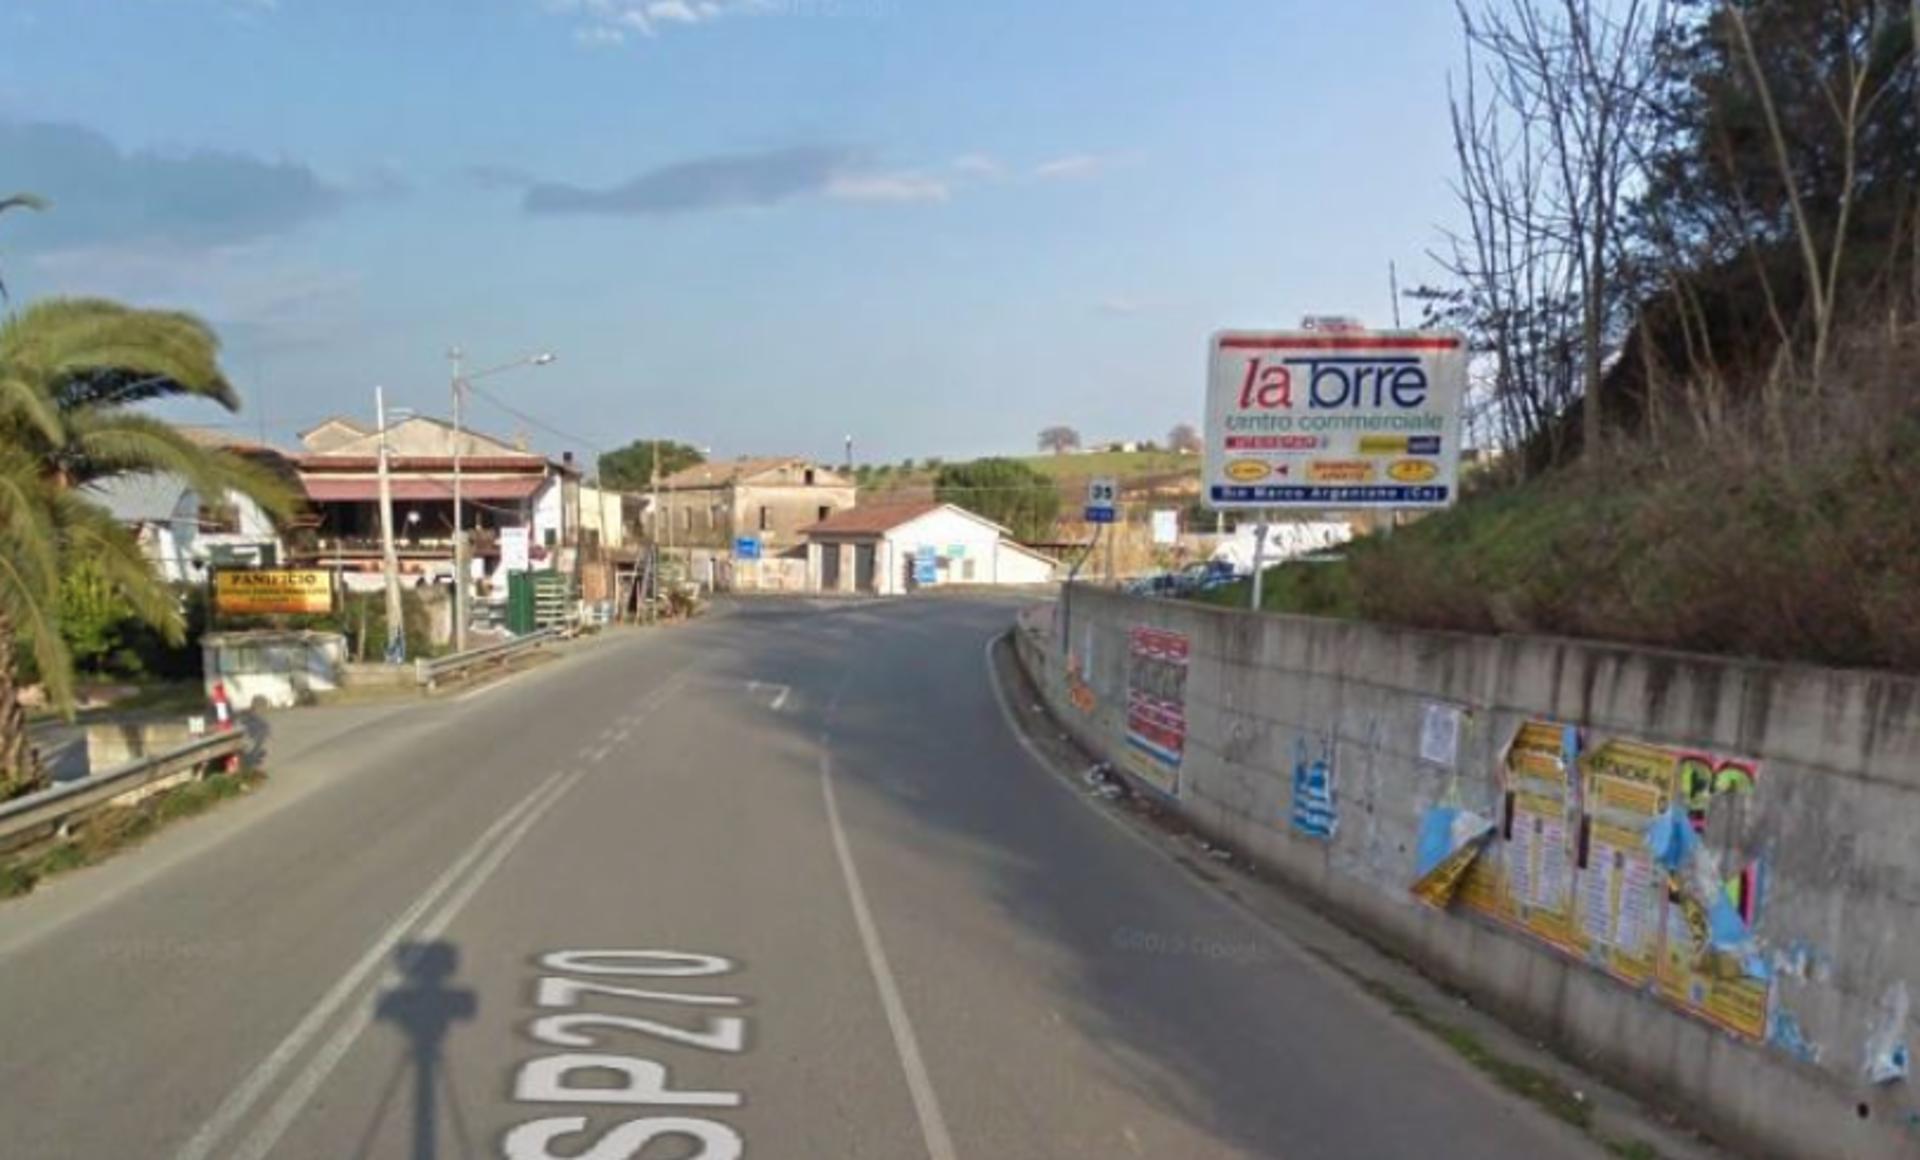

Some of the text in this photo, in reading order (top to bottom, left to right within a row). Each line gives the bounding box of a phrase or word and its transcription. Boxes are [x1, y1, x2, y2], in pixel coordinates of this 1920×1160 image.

[1238, 357, 1428, 410] la Torre
[1225, 412, 1444, 431] centro commerciale
[502, 949, 743, 1160] SP270
